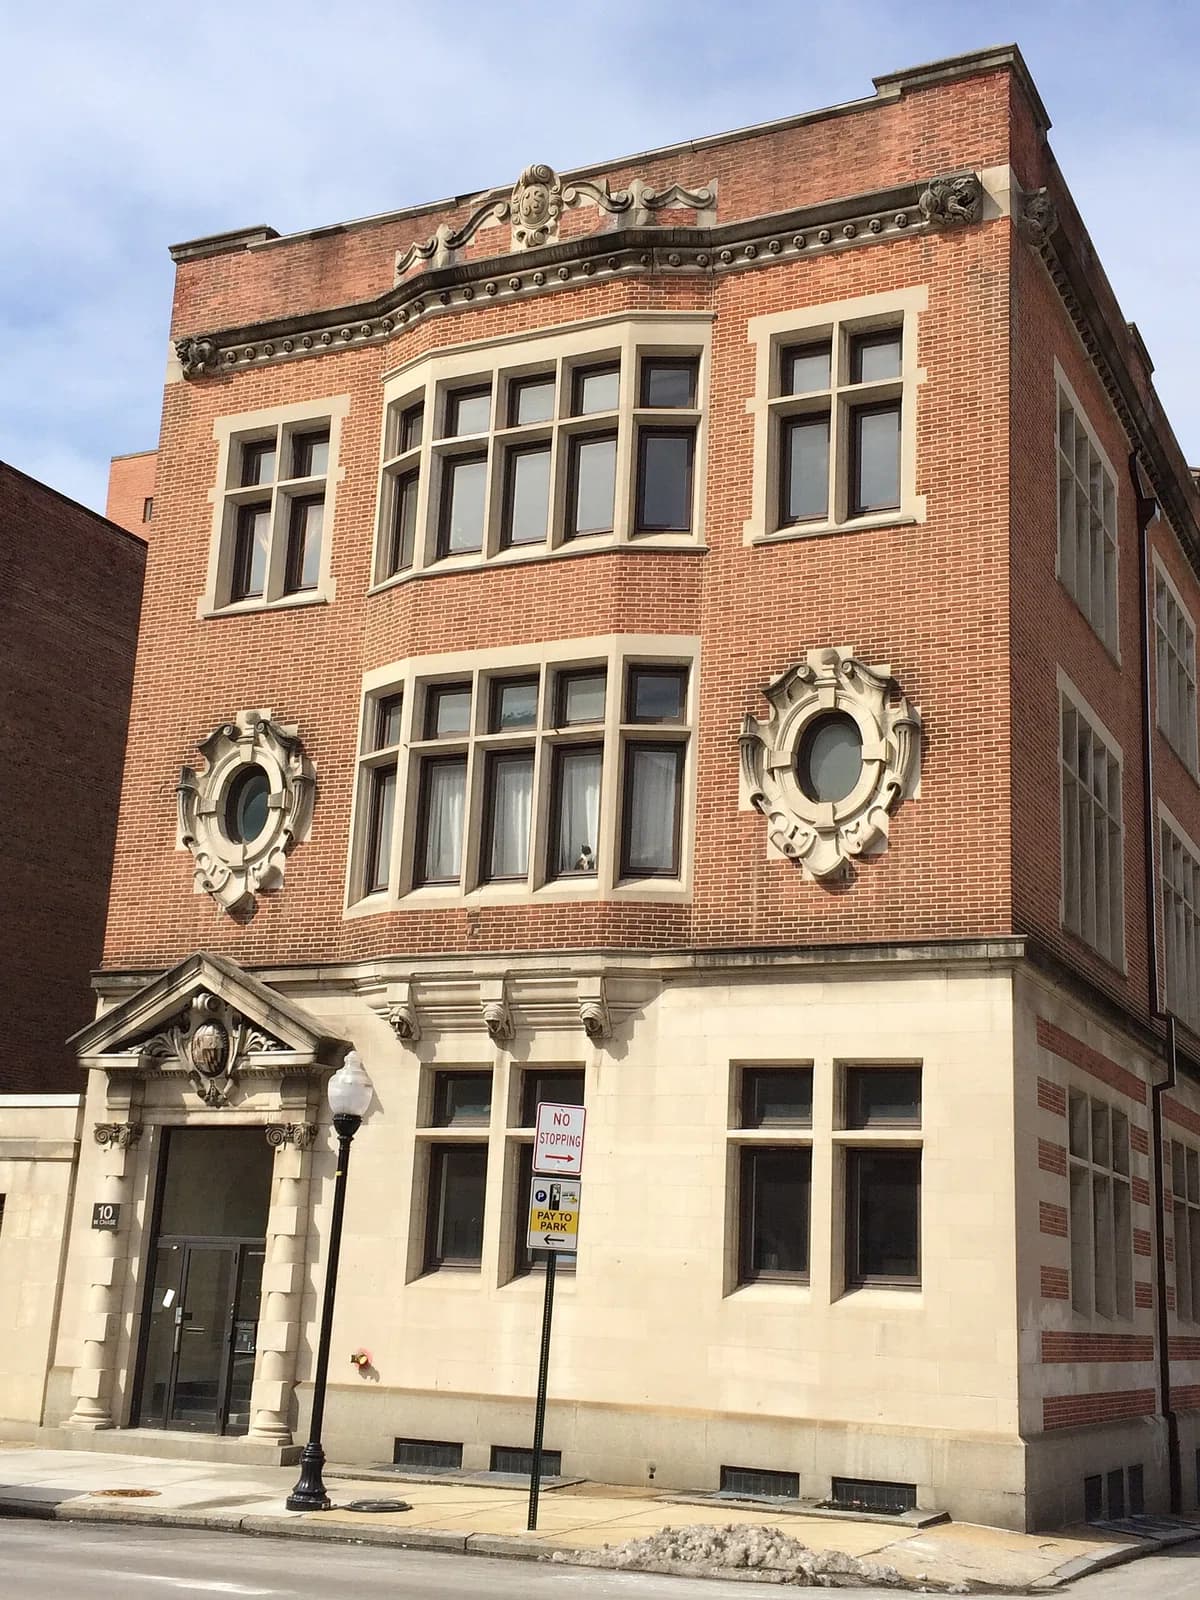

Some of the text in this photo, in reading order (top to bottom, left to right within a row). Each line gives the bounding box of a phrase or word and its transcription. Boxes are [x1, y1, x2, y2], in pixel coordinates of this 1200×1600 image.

[553, 1112, 570, 1127] NO
[540, 1132, 581, 1148] STOPPING
[98, 1205, 113, 1219] 10
[537, 1211, 572, 1222] PAY TO
[540, 1221, 567, 1232] PARK
